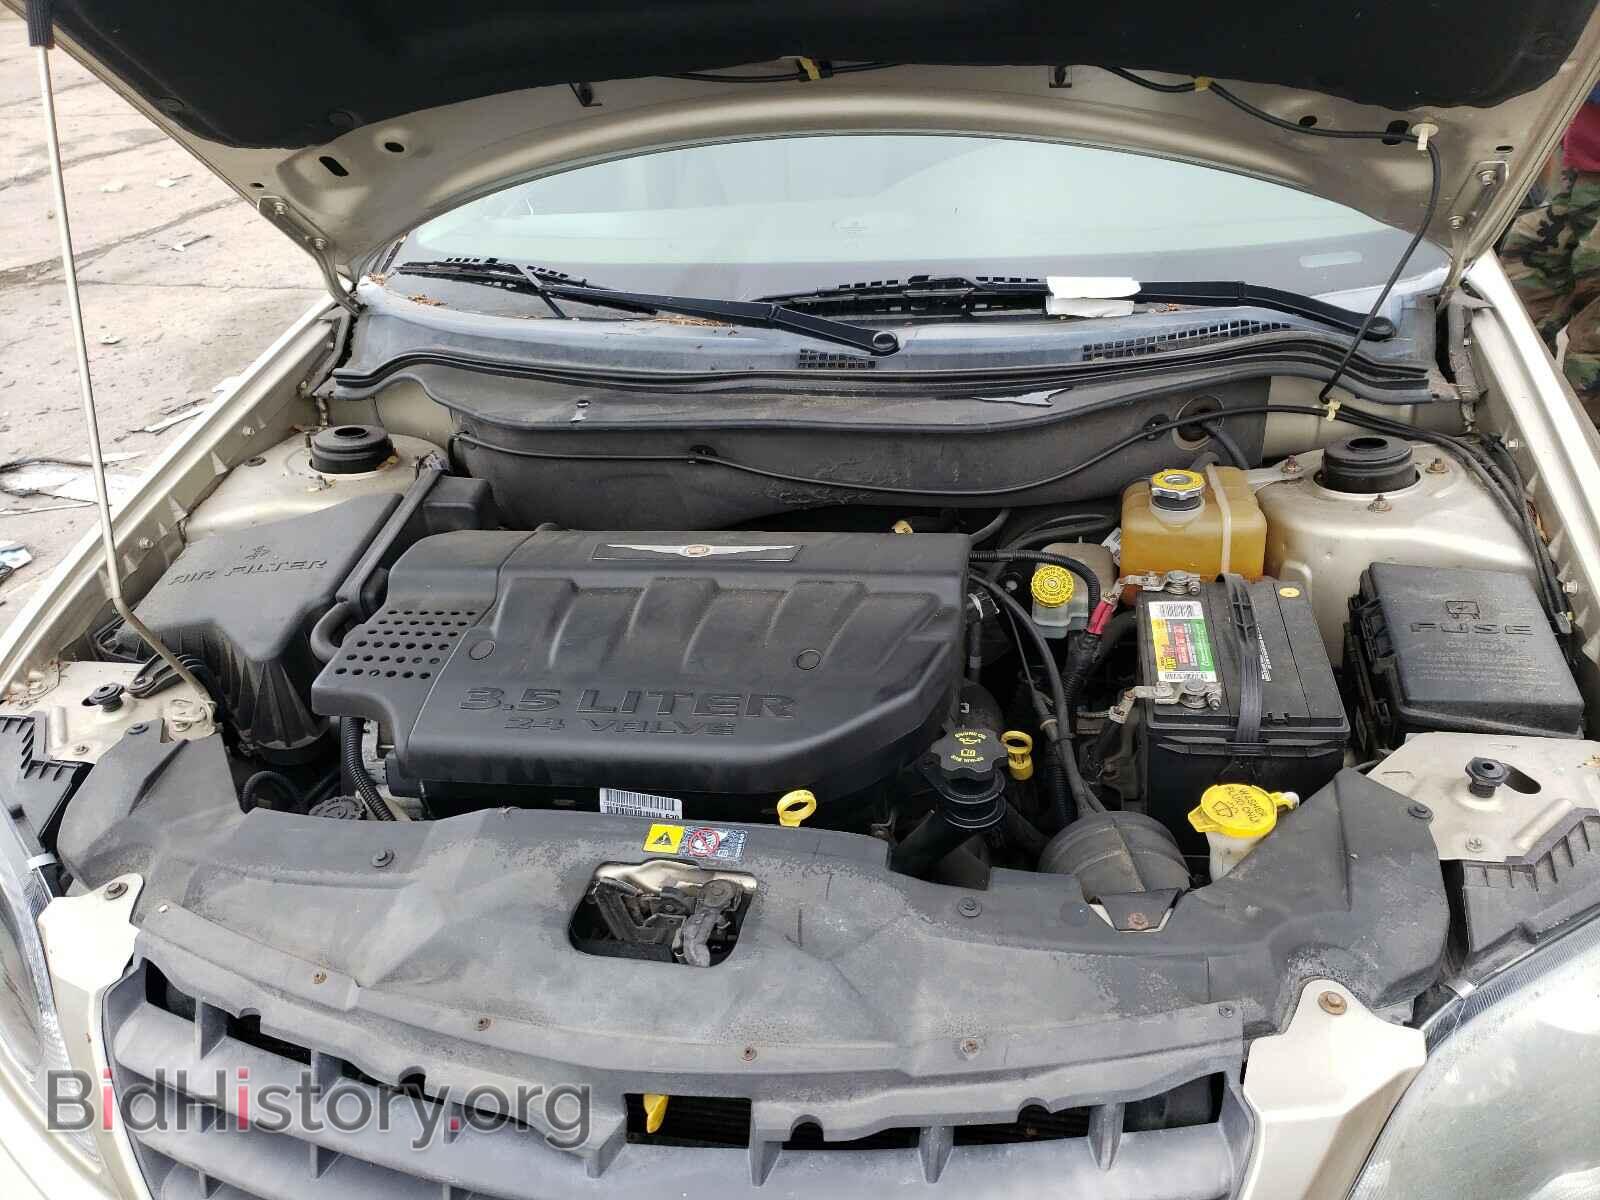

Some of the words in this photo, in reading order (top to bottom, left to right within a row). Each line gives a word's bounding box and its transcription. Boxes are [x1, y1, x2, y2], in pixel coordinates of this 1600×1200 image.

[168, 569, 217, 586] AIR
[224, 558, 328, 577] FILTER
[1410, 622, 1535, 635] FUSE
[459, 687, 562, 713] 3.5
[575, 688, 798, 719] LITER
[504, 717, 566, 731] 24
[582, 718, 737, 736] VALVE
